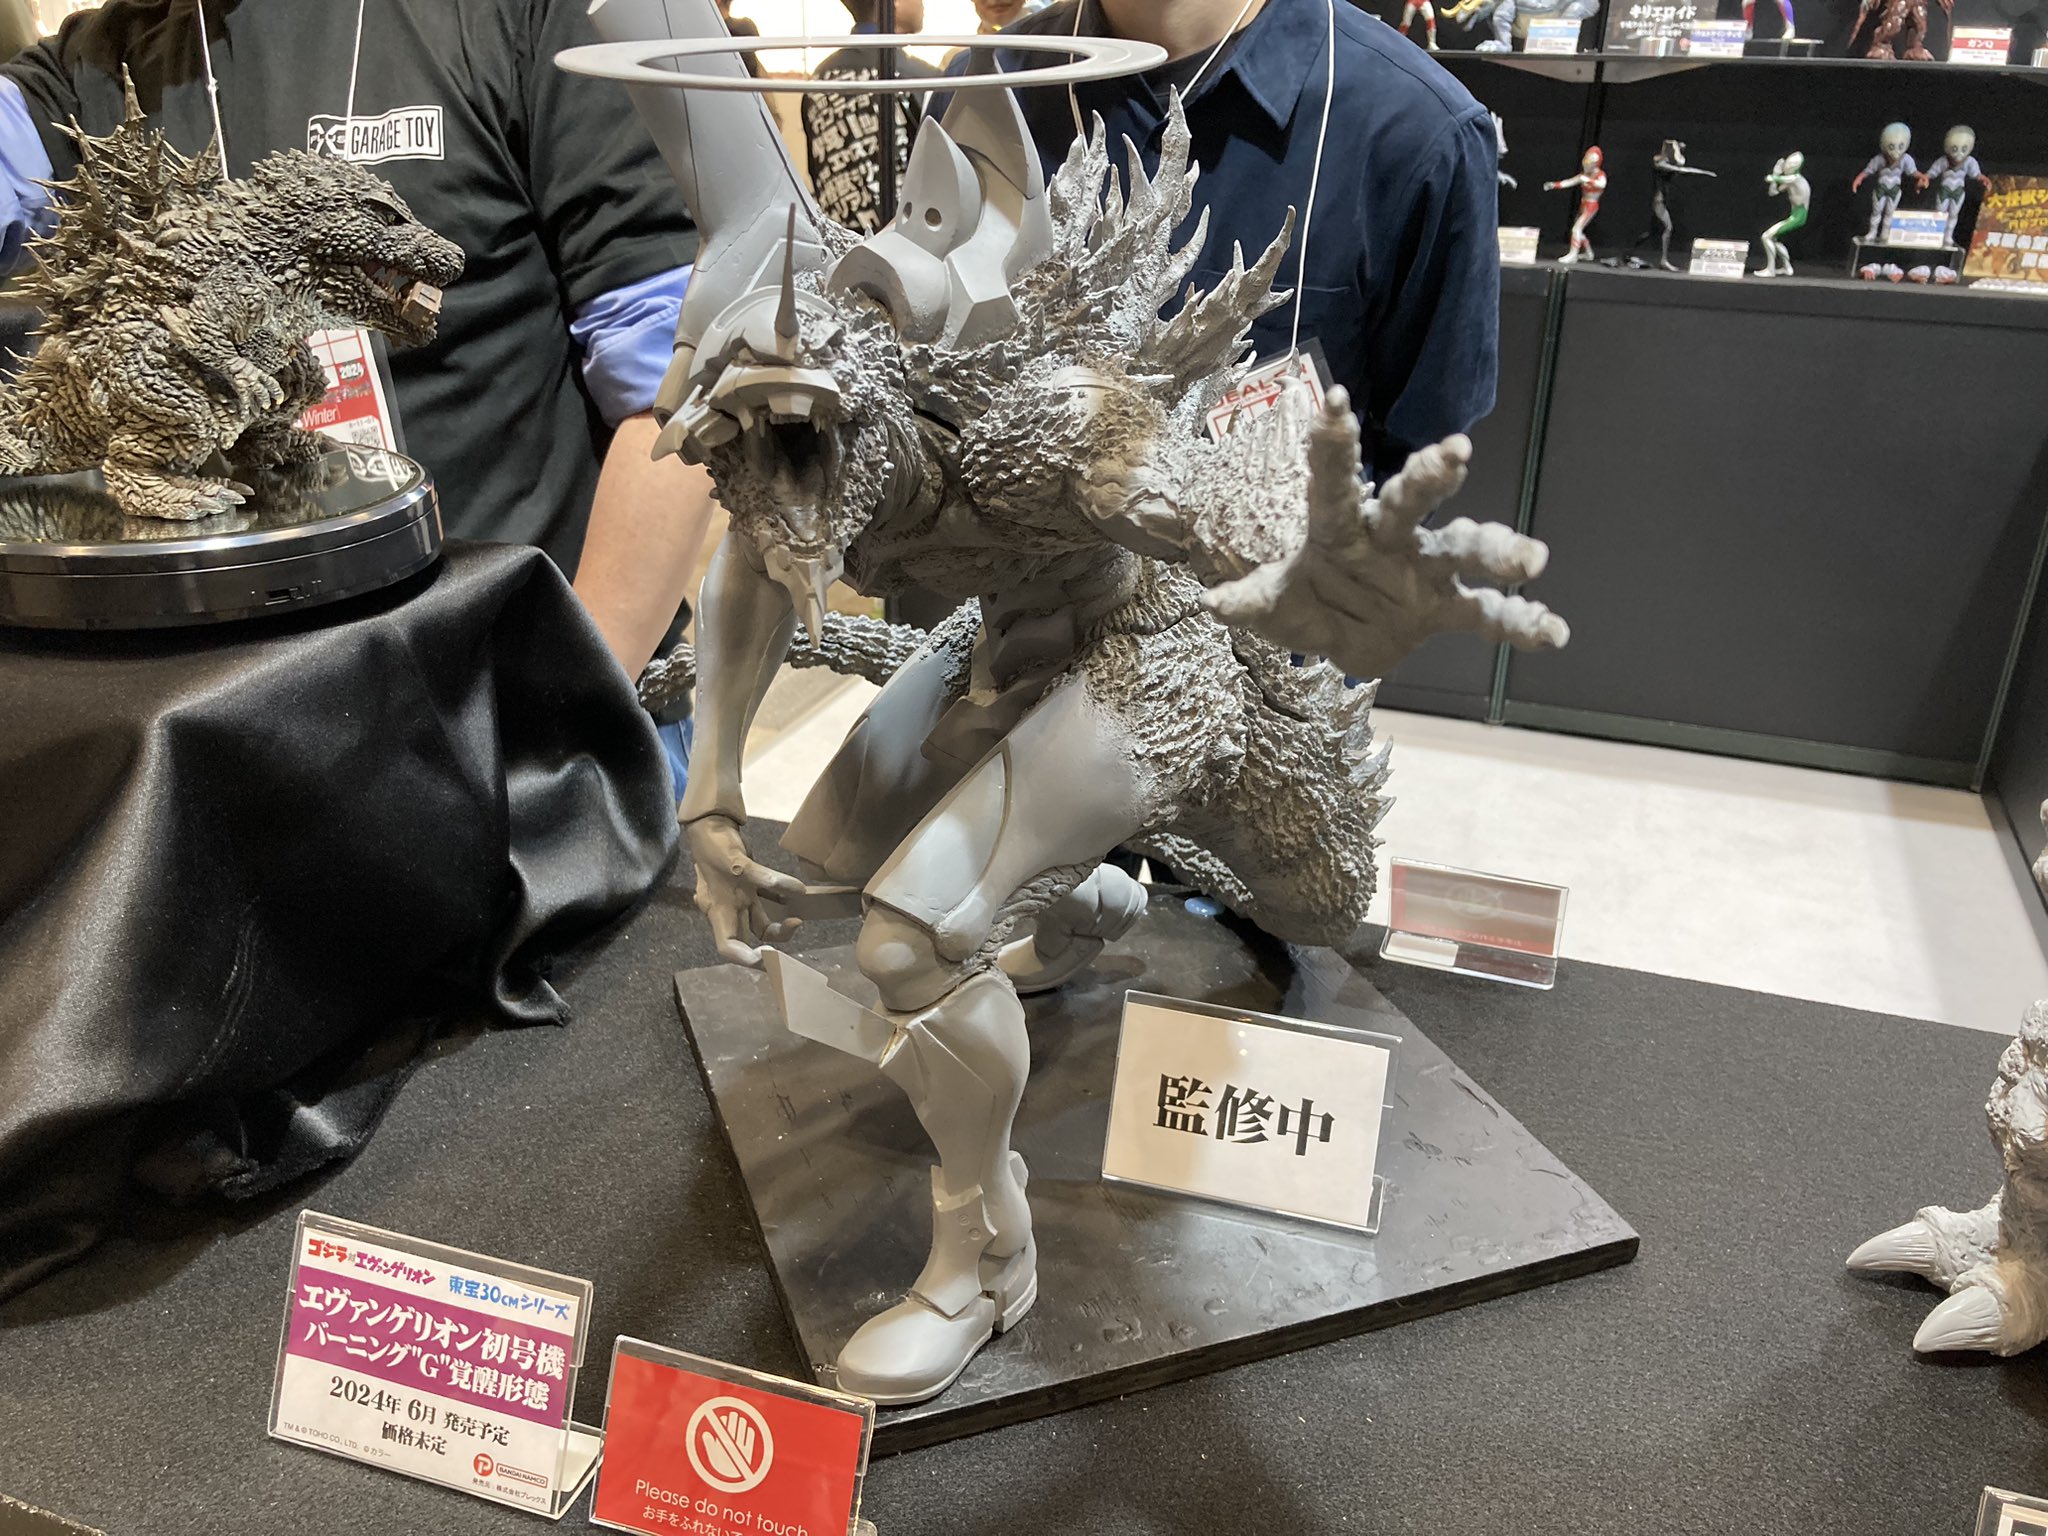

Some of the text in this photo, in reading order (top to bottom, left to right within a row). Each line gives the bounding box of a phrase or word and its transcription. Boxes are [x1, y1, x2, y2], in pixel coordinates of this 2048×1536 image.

[351, 116, 435, 155] GARAGE TOY
[302, 406, 338, 428] Winter
[1153, 1073, 1335, 1156] 監修中
[299, 1283, 566, 1381] エヴァンゲリオン初号機
[329, 1375, 511, 1447] 2024年 6月 発売予定
[308, 1427, 329, 1440] TOHO
[381, 1421, 448, 1456] 価格未定
[499, 1466, 546, 1485] BANDAI NAMCO
[635, 1479, 808, 1536] Please do not touch
